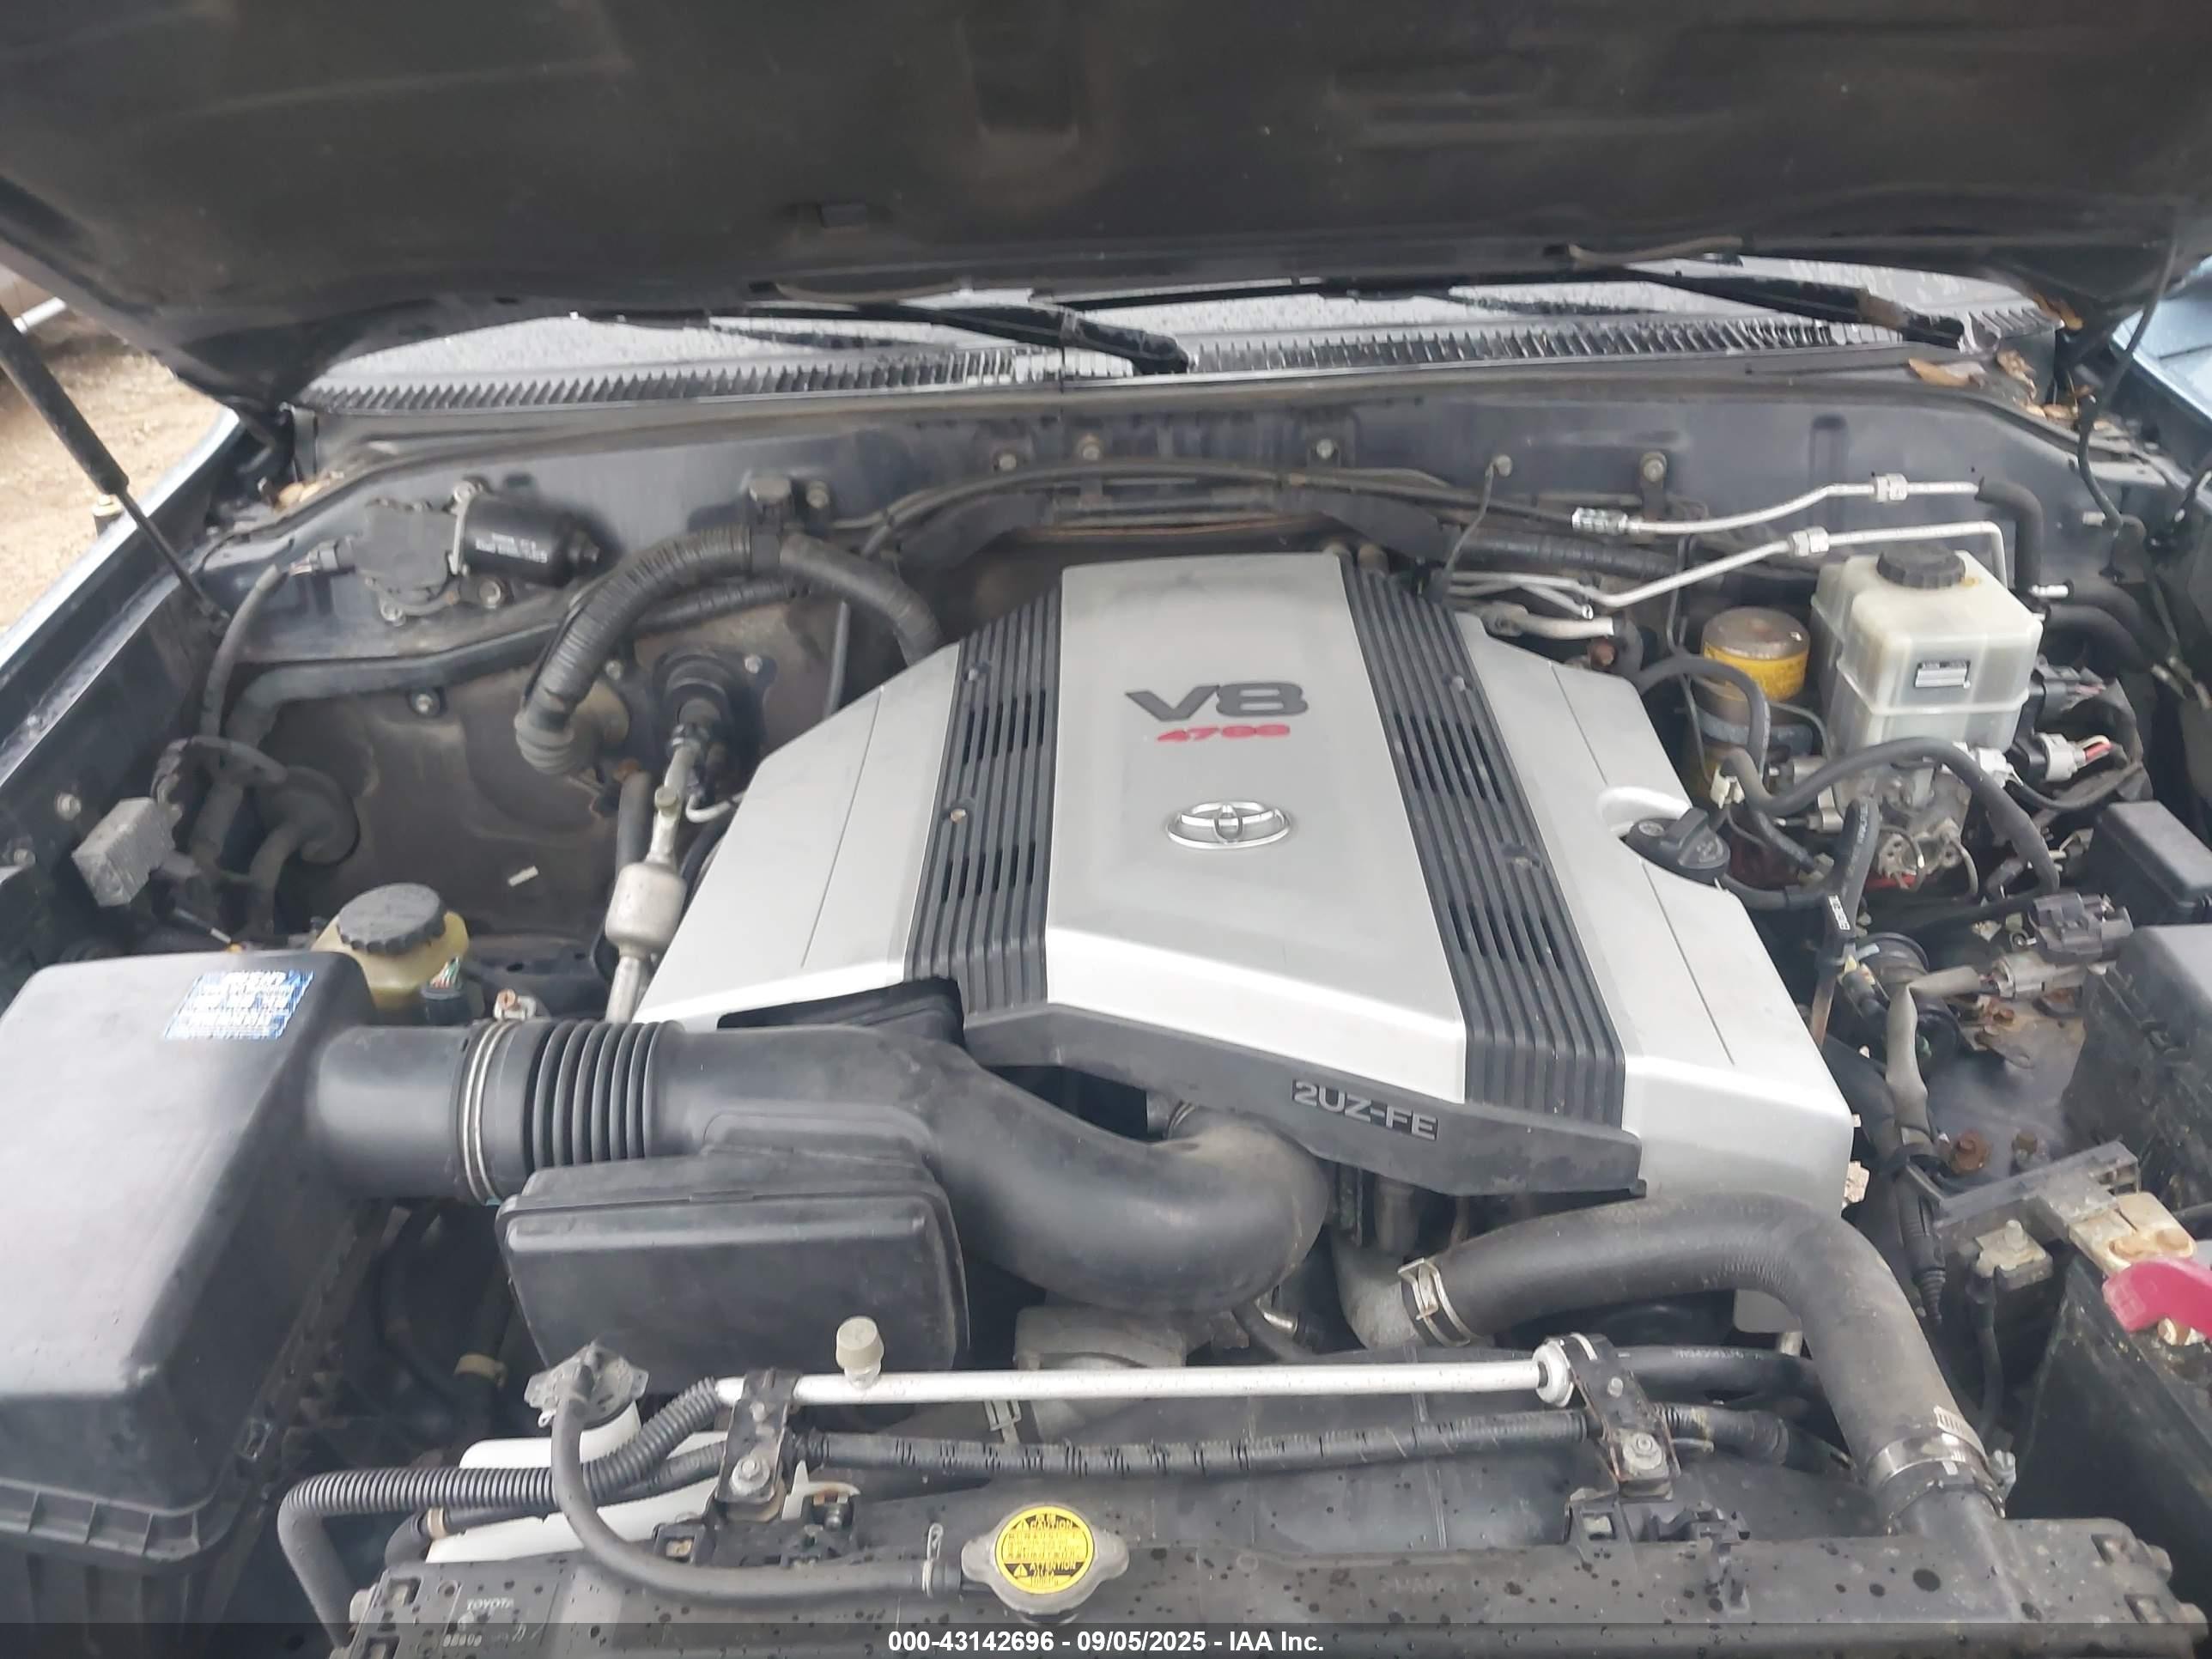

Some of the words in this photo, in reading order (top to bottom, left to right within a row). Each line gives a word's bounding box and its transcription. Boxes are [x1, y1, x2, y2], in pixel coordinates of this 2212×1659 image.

[1125, 682, 1309, 722] V8
[1292, 1080, 1439, 1141] 2UZ-FE
[466, 1598, 514, 1611] TOYOTA
